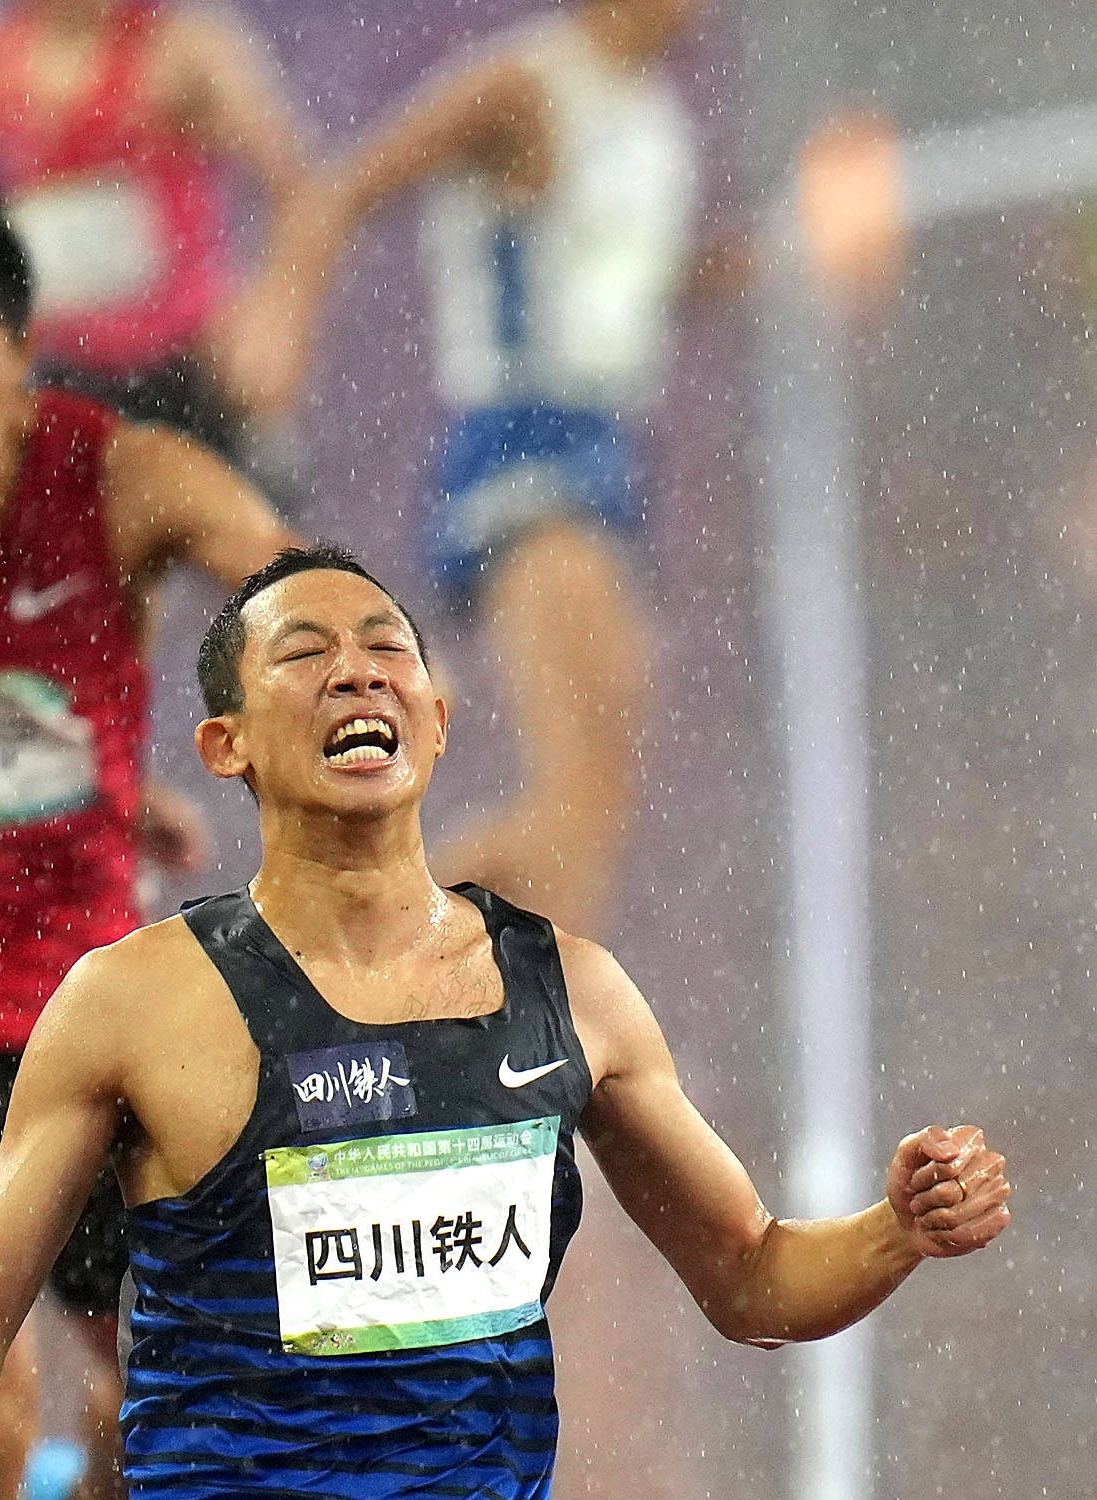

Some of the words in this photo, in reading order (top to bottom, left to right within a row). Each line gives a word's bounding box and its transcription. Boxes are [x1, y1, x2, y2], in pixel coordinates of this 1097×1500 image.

[293, 1057, 410, 1108] 四川铁人
[304, 1204, 532, 1286] 四川铁人
